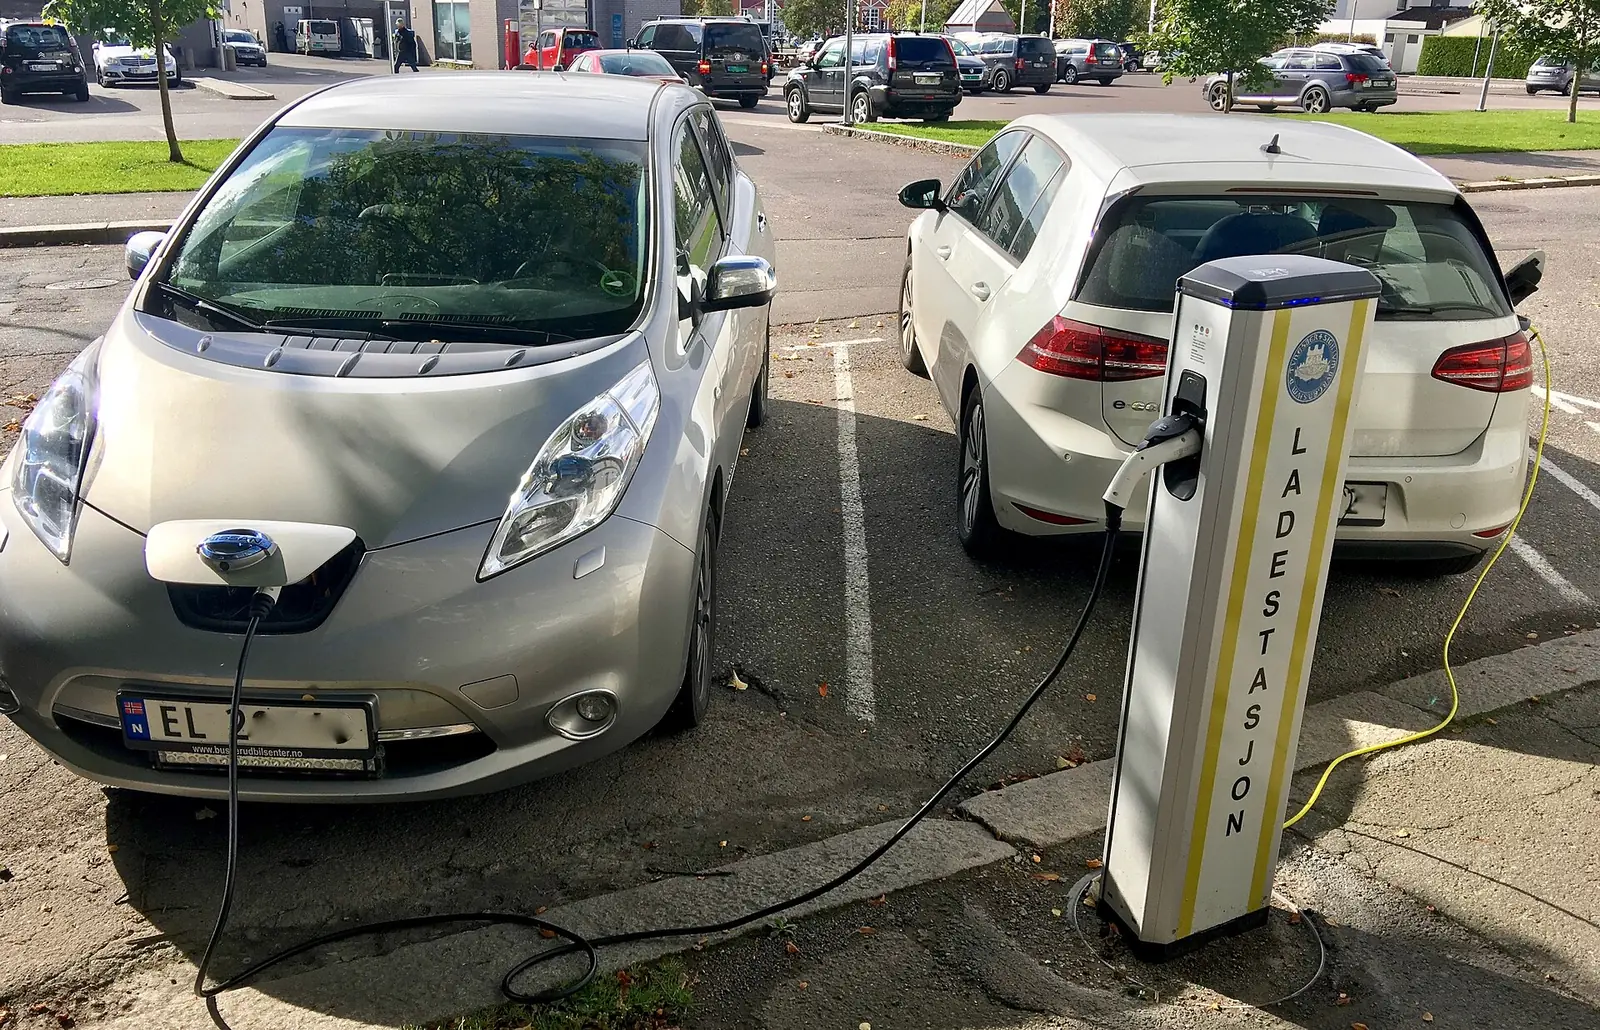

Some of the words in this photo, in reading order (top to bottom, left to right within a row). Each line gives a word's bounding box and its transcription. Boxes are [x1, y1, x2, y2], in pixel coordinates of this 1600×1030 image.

[1225, 427, 1306, 837] LADESTASJON
[131, 723, 143, 734] N
[160, 705, 206, 739] EL
